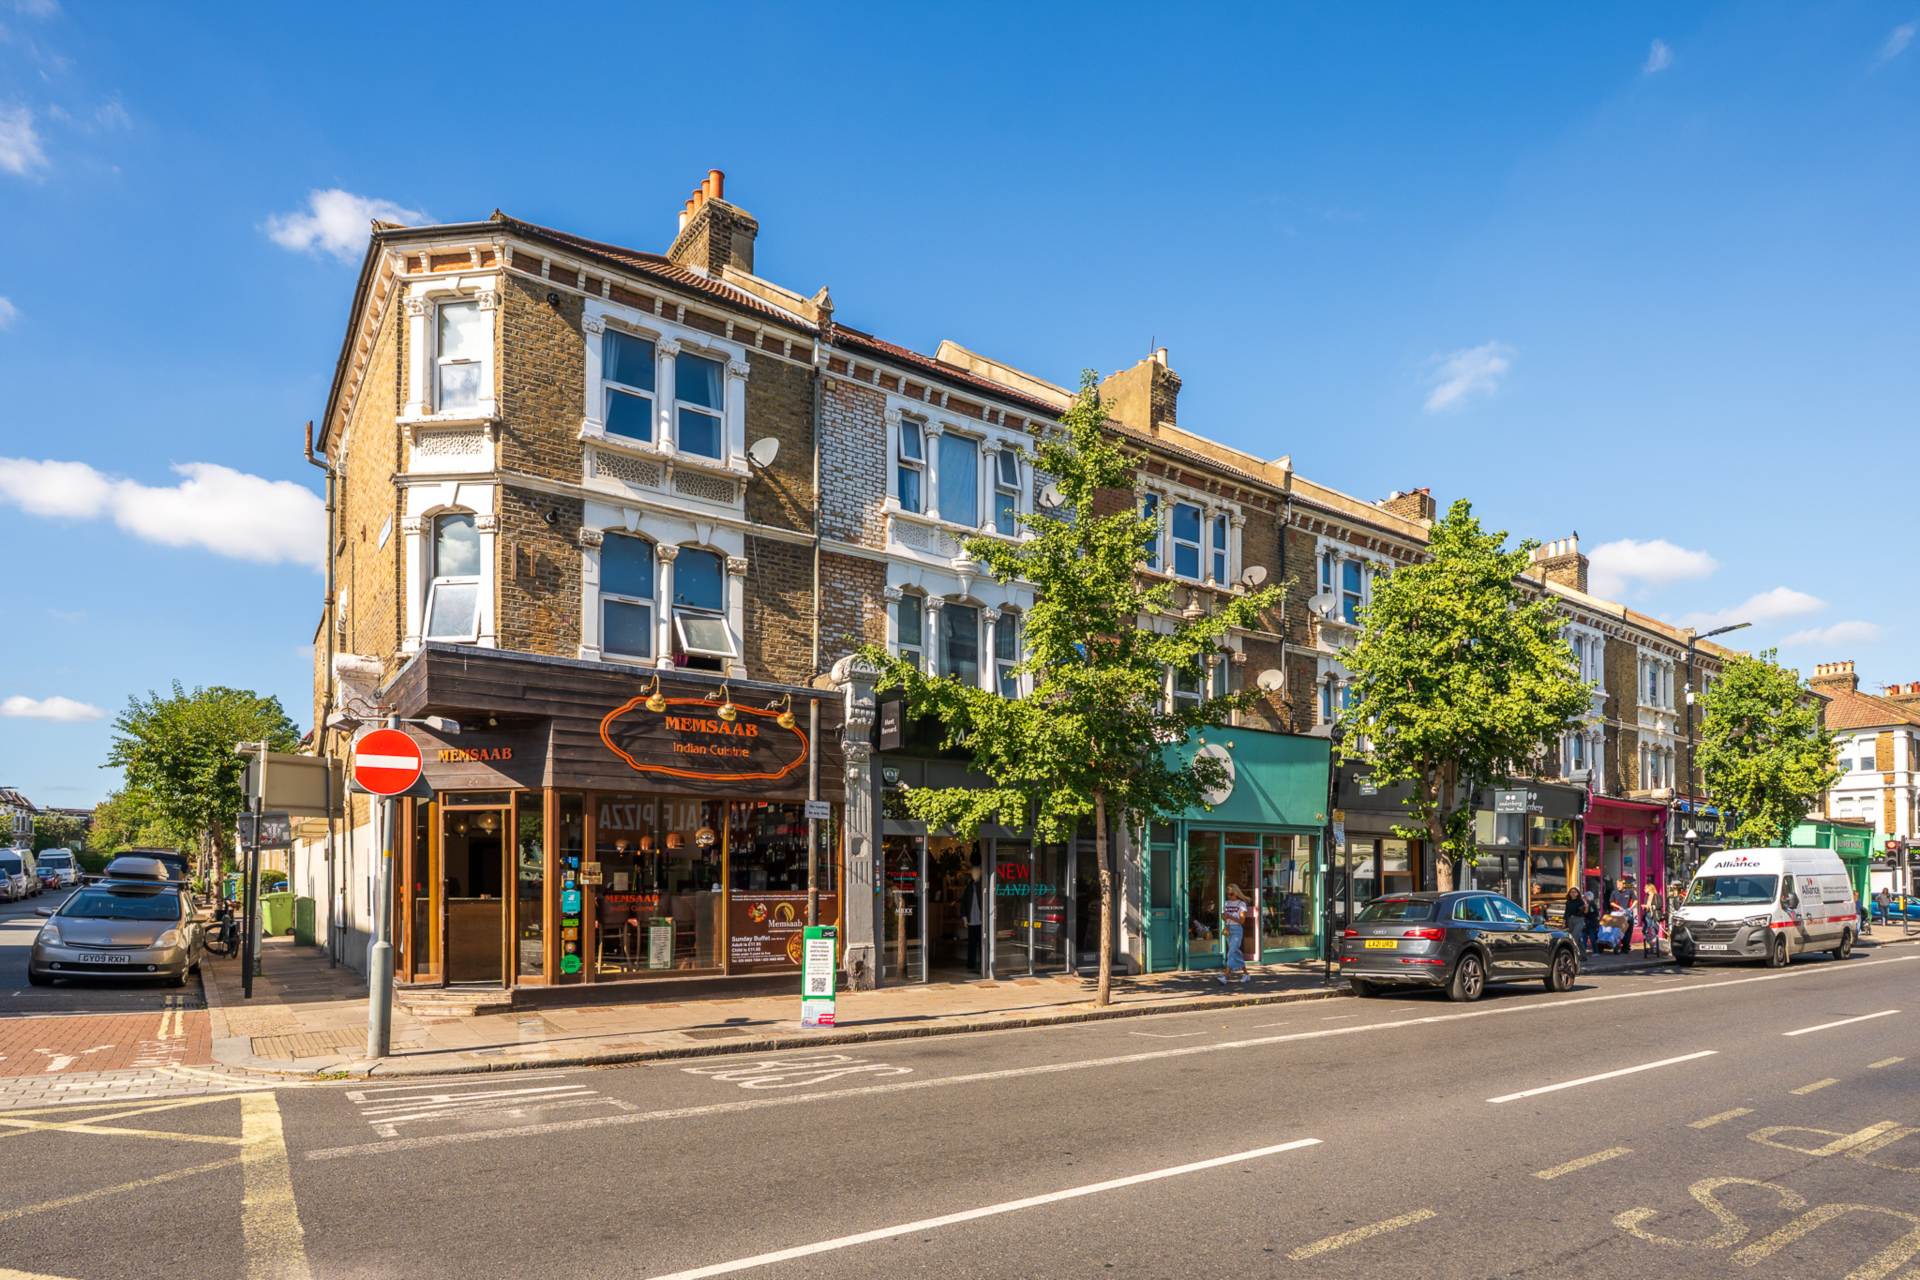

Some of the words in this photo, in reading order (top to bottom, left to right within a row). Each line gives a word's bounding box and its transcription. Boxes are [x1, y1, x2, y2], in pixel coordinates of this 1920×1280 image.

[665, 715, 758, 737] MEMSAAB
[438, 747, 513, 762] MEMSAAB
[673, 742, 706, 754] Indian
[709, 744, 750, 757] Cuisine
[1681, 819, 1714, 833] DUWICH
[1714, 860, 1761, 869] Alliance
[996, 863, 1031, 881] NEW
[1801, 883, 1820, 895] Alliance
[768, 919, 803, 928] Memsaab
